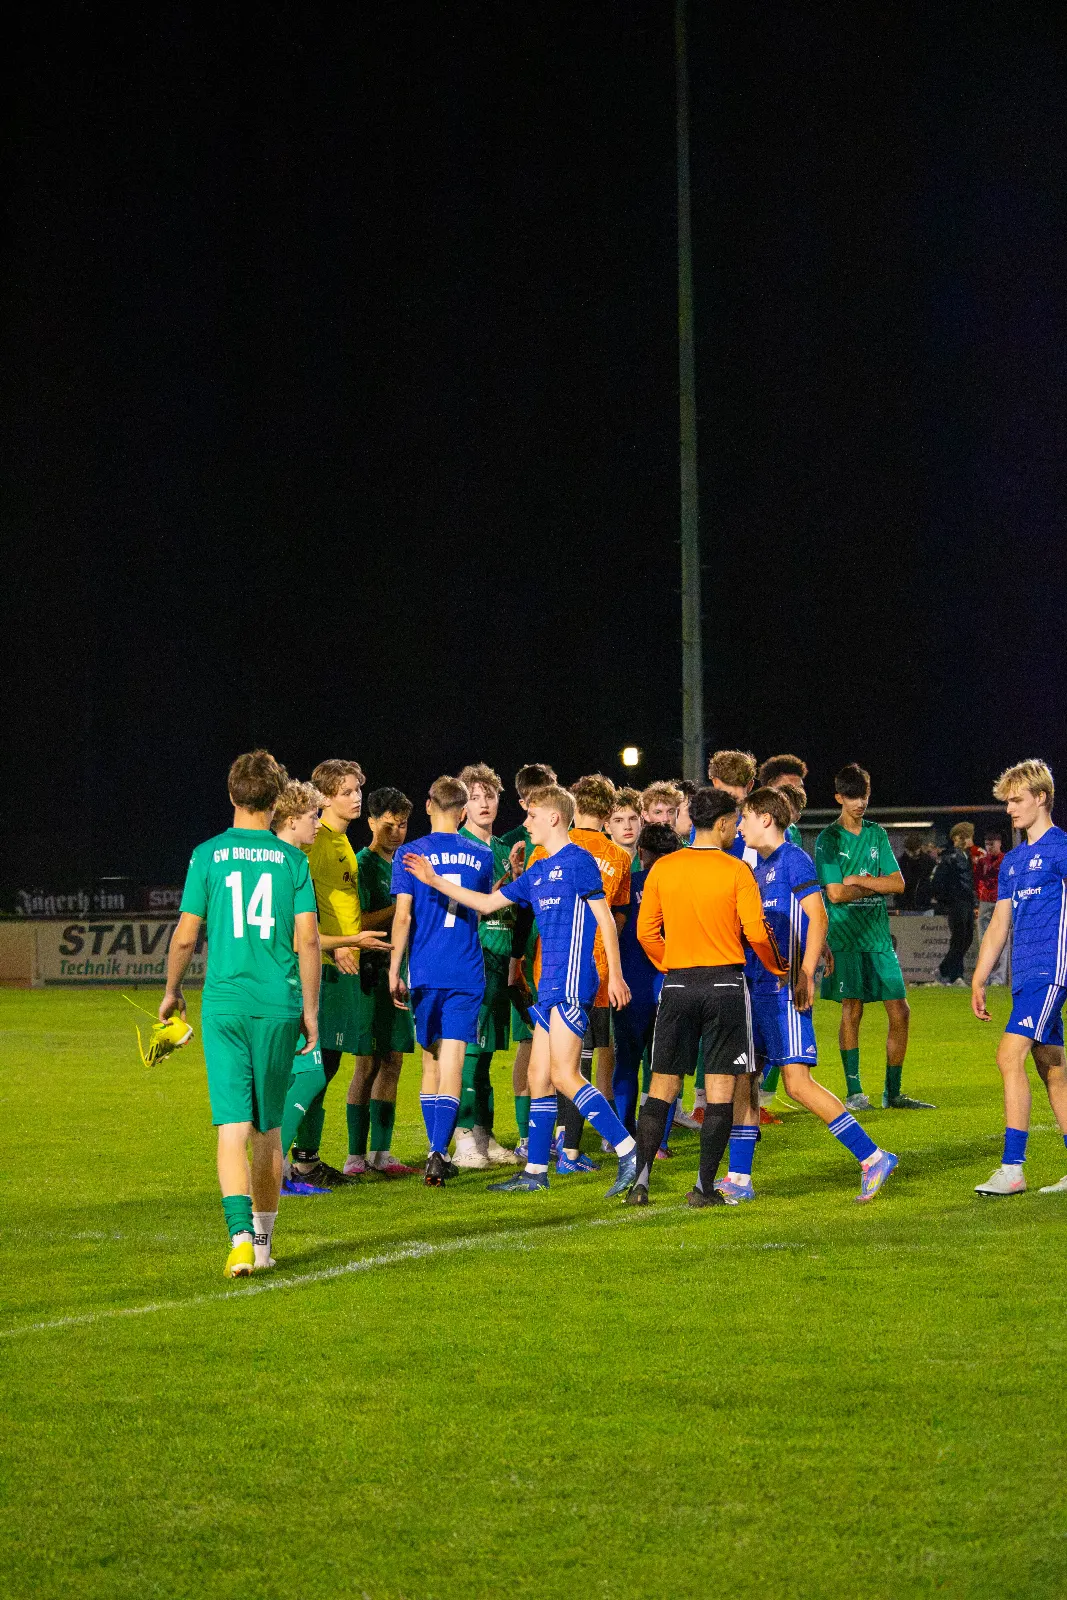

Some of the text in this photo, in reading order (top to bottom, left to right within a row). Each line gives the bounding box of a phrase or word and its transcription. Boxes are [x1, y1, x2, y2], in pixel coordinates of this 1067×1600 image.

[214, 848, 230, 863] GW
[225, 871, 276, 940] 14
[60, 958, 122, 976] Technik
[126, 958, 166, 976] rund
[312, 1050, 322, 1065] 13
